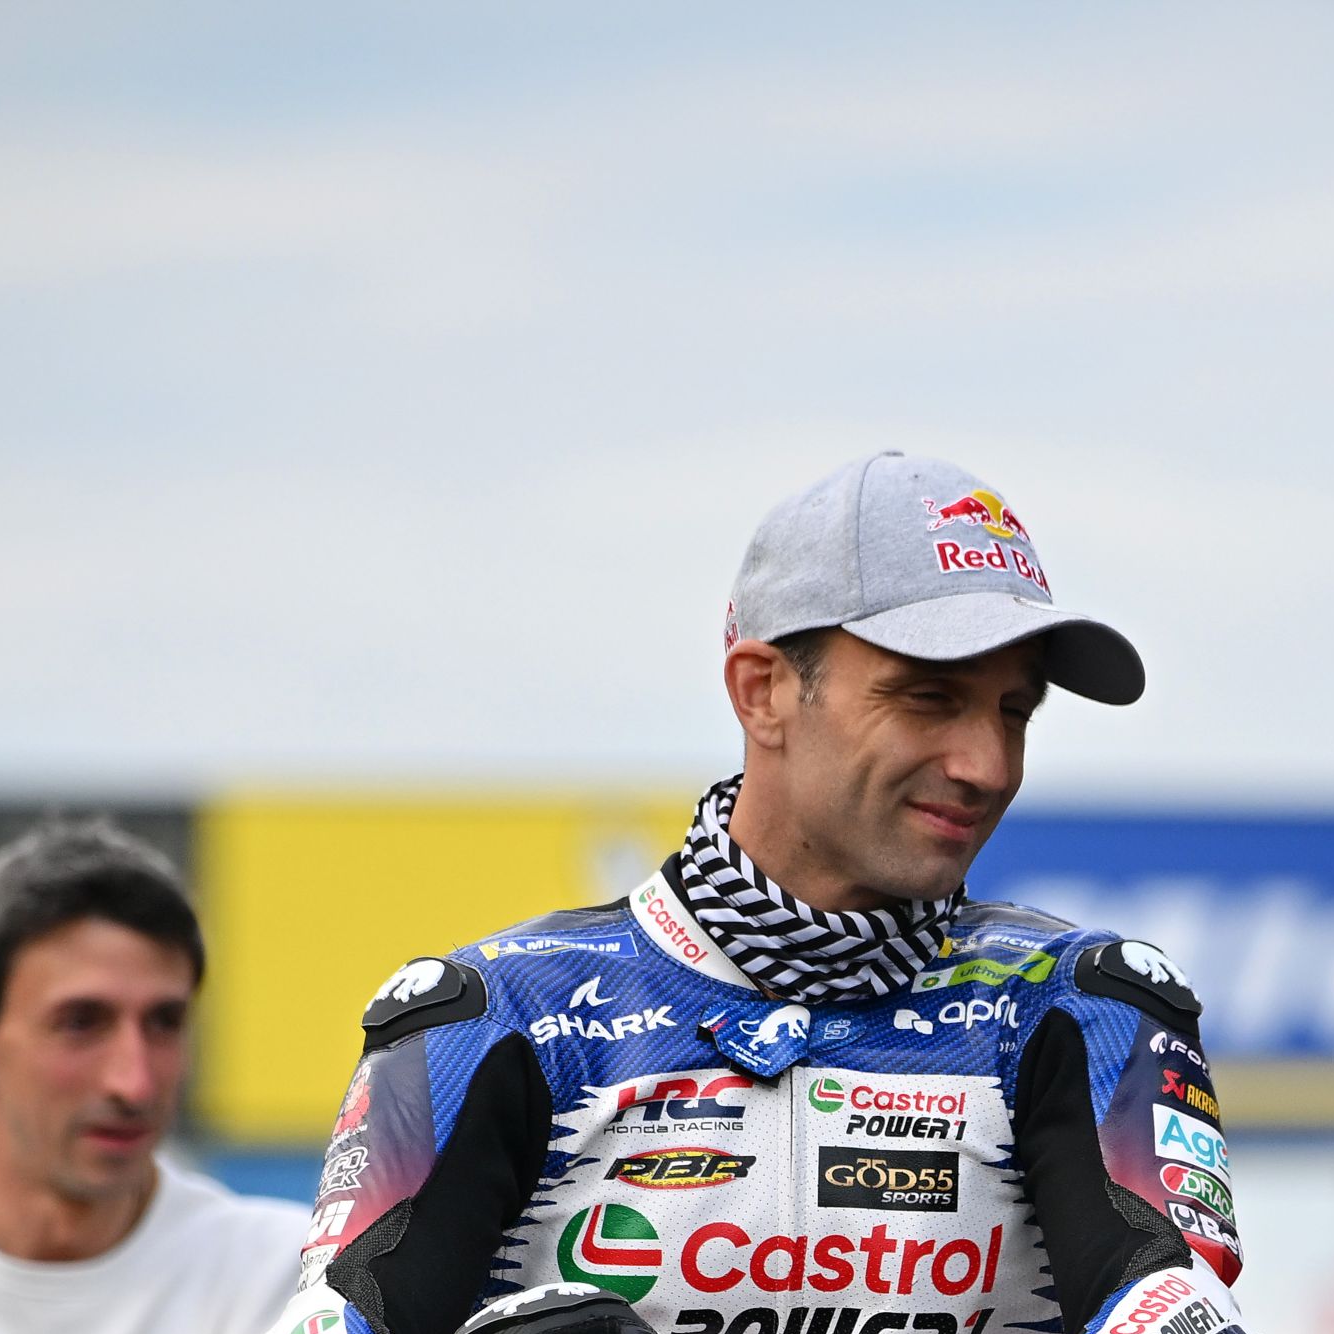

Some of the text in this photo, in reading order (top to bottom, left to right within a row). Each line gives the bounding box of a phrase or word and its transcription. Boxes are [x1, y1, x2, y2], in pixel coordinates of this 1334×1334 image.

[935, 540, 1009, 573] Red
[646, 897, 709, 965] Castrol
[529, 1005, 678, 1045] SHARK
[615, 1075, 755, 1121] HRC
[850, 1086, 966, 1115] Castrol
[603, 1121, 745, 1135] Honda RACING
[845, 1114, 967, 1141] POWER1
[603, 1154, 757, 1182] PBR
[880, 1191, 953, 1205] SPORTS
[679, 1221, 1004, 1297] Castrol
